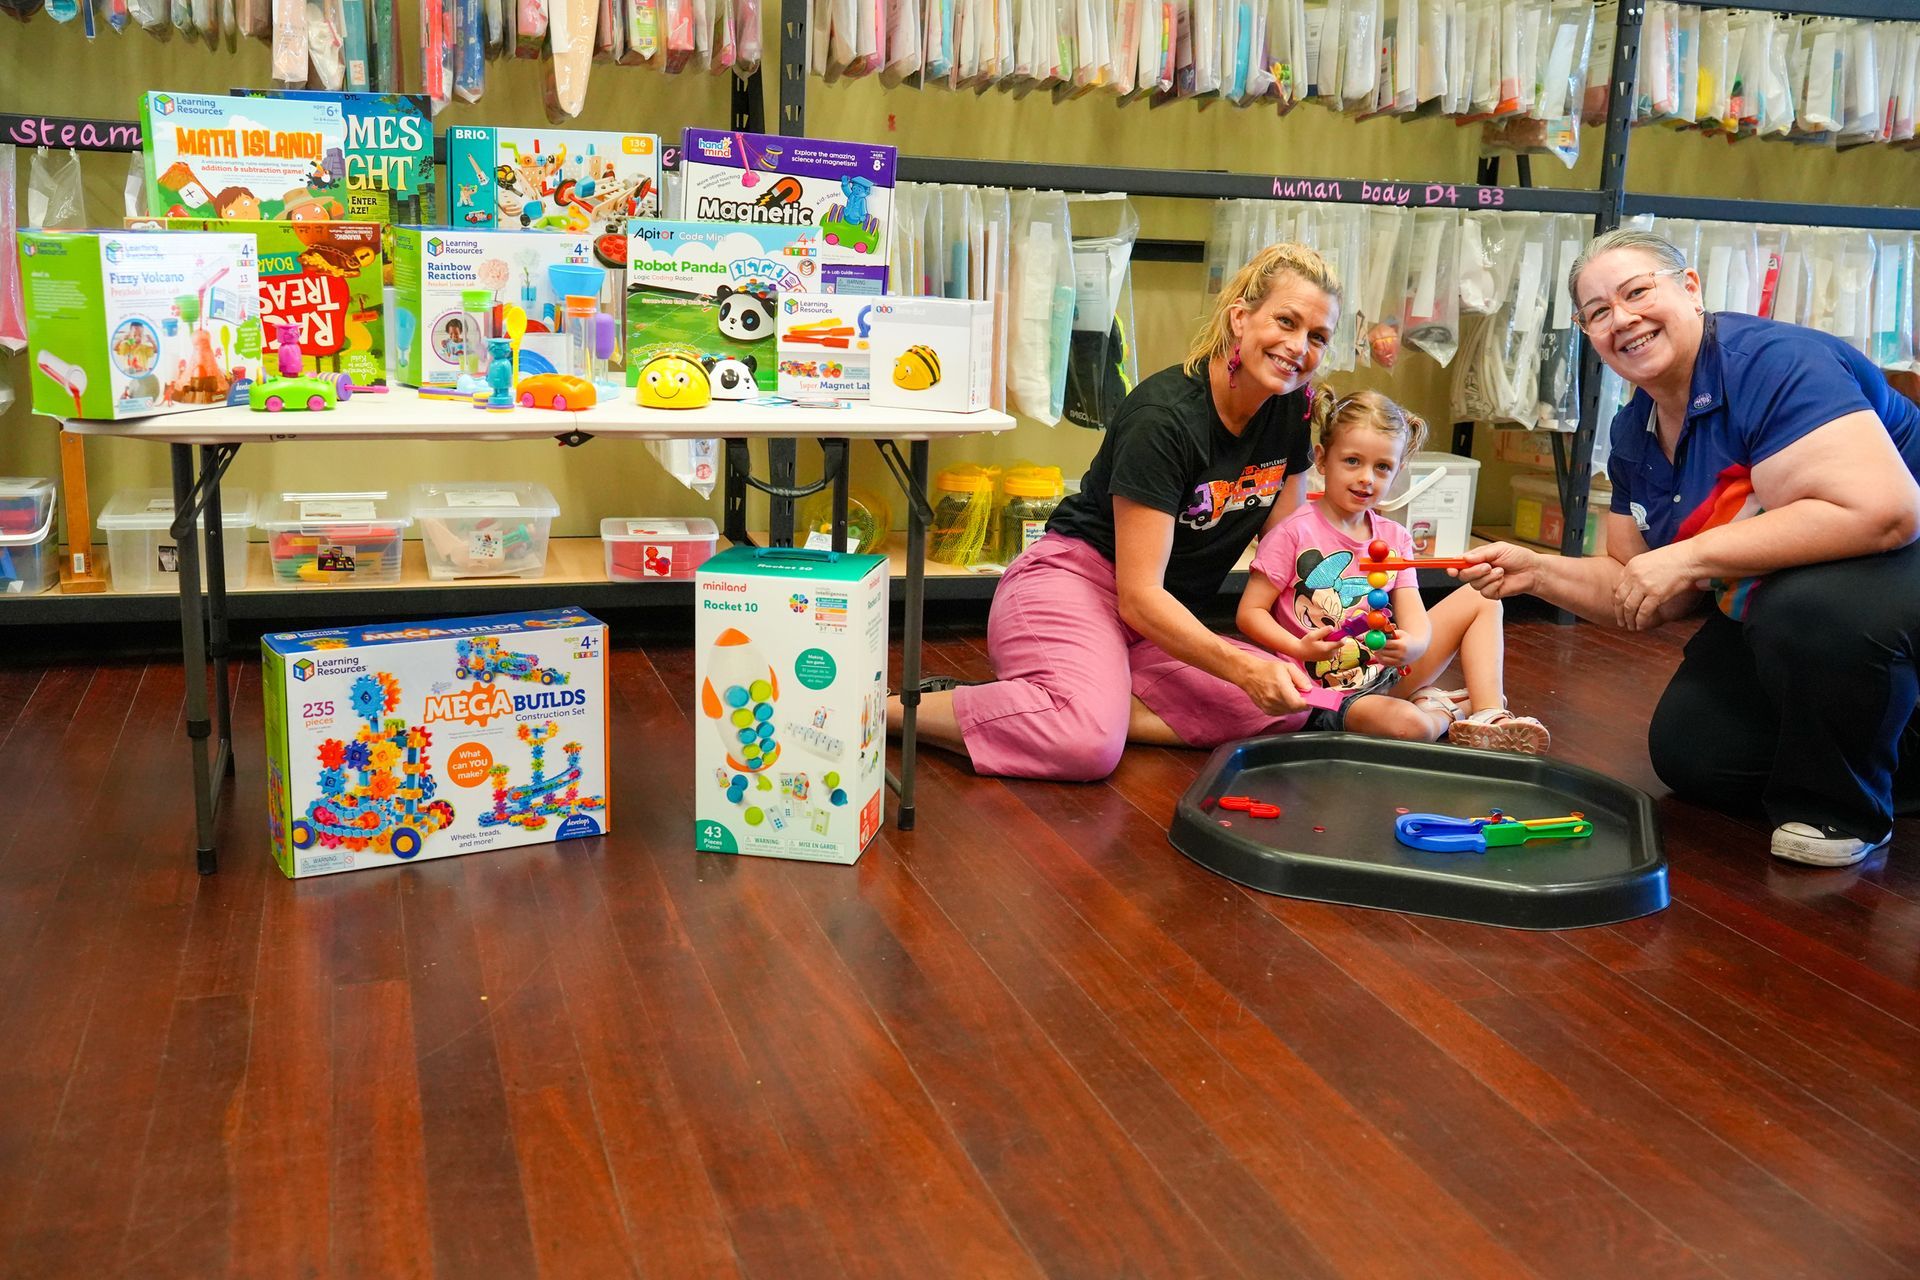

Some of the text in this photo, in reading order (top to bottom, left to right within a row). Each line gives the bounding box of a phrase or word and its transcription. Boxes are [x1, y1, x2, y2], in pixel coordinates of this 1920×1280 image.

[176, 97, 216, 108] Learning
[177, 105, 223, 116] Resources
[326, 105, 339, 117] 6+
[9, 118, 144, 146] steam
[341, 115, 423, 151] MES
[455, 129, 487, 140] BRIO
[175, 127, 323, 161] MATH ISLAND!
[630, 140, 647, 148] 136
[704, 148, 731, 158] mind
[794, 149, 817, 157] Explore
[829, 153, 855, 161] amazing
[791, 156, 814, 164] science
[822, 159, 858, 167] magnetism!
[240, 166, 282, 174] subtraction
[344, 154, 413, 192] GHT
[1272, 177, 1505, 206] human body D4 B3
[351, 196, 378, 206] ENTER
[348, 206, 369, 215] AZE!
[698, 197, 814, 225] Magnetic
[633, 227, 727, 242] Apitor Code Mini
[797, 232, 816, 246] 4+
[445, 239, 477, 248] Learning
[241, 243, 255, 259] 4+
[445, 246, 483, 255] Resources
[574, 243, 589, 256] 4+
[783, 247, 817, 257] STEM
[427, 262, 472, 271] Rainbow
[633, 259, 727, 274] Robot Panda
[109, 271, 185, 287] Fizzy Volcano
[240, 274, 249, 283] 13
[427, 271, 477, 280] Reactions
[799, 301, 828, 309] Learning
[799, 306, 833, 314] Resources
[819, 381, 855, 391] Magnet
[703, 581, 747, 593] miniland
[704, 599, 758, 613] Rocket 10
[581, 635, 599, 650] 4+
[317, 657, 359, 668] Learning
[317, 665, 367, 676] Resources
[302, 701, 335, 719] 235
[424, 688, 586, 723] MEGA BUILDS
[515, 707, 585, 722] Construction Set
[305, 718, 334, 729] pieces
[459, 750, 481, 759] What
[469, 758, 488, 768] YOU
[457, 769, 484, 780] make?
[450, 829, 502, 842] Wheels, treads,
[703, 826, 722, 839] 43
[459, 838, 494, 848] and more!
[703, 838, 723, 846] Pieces
